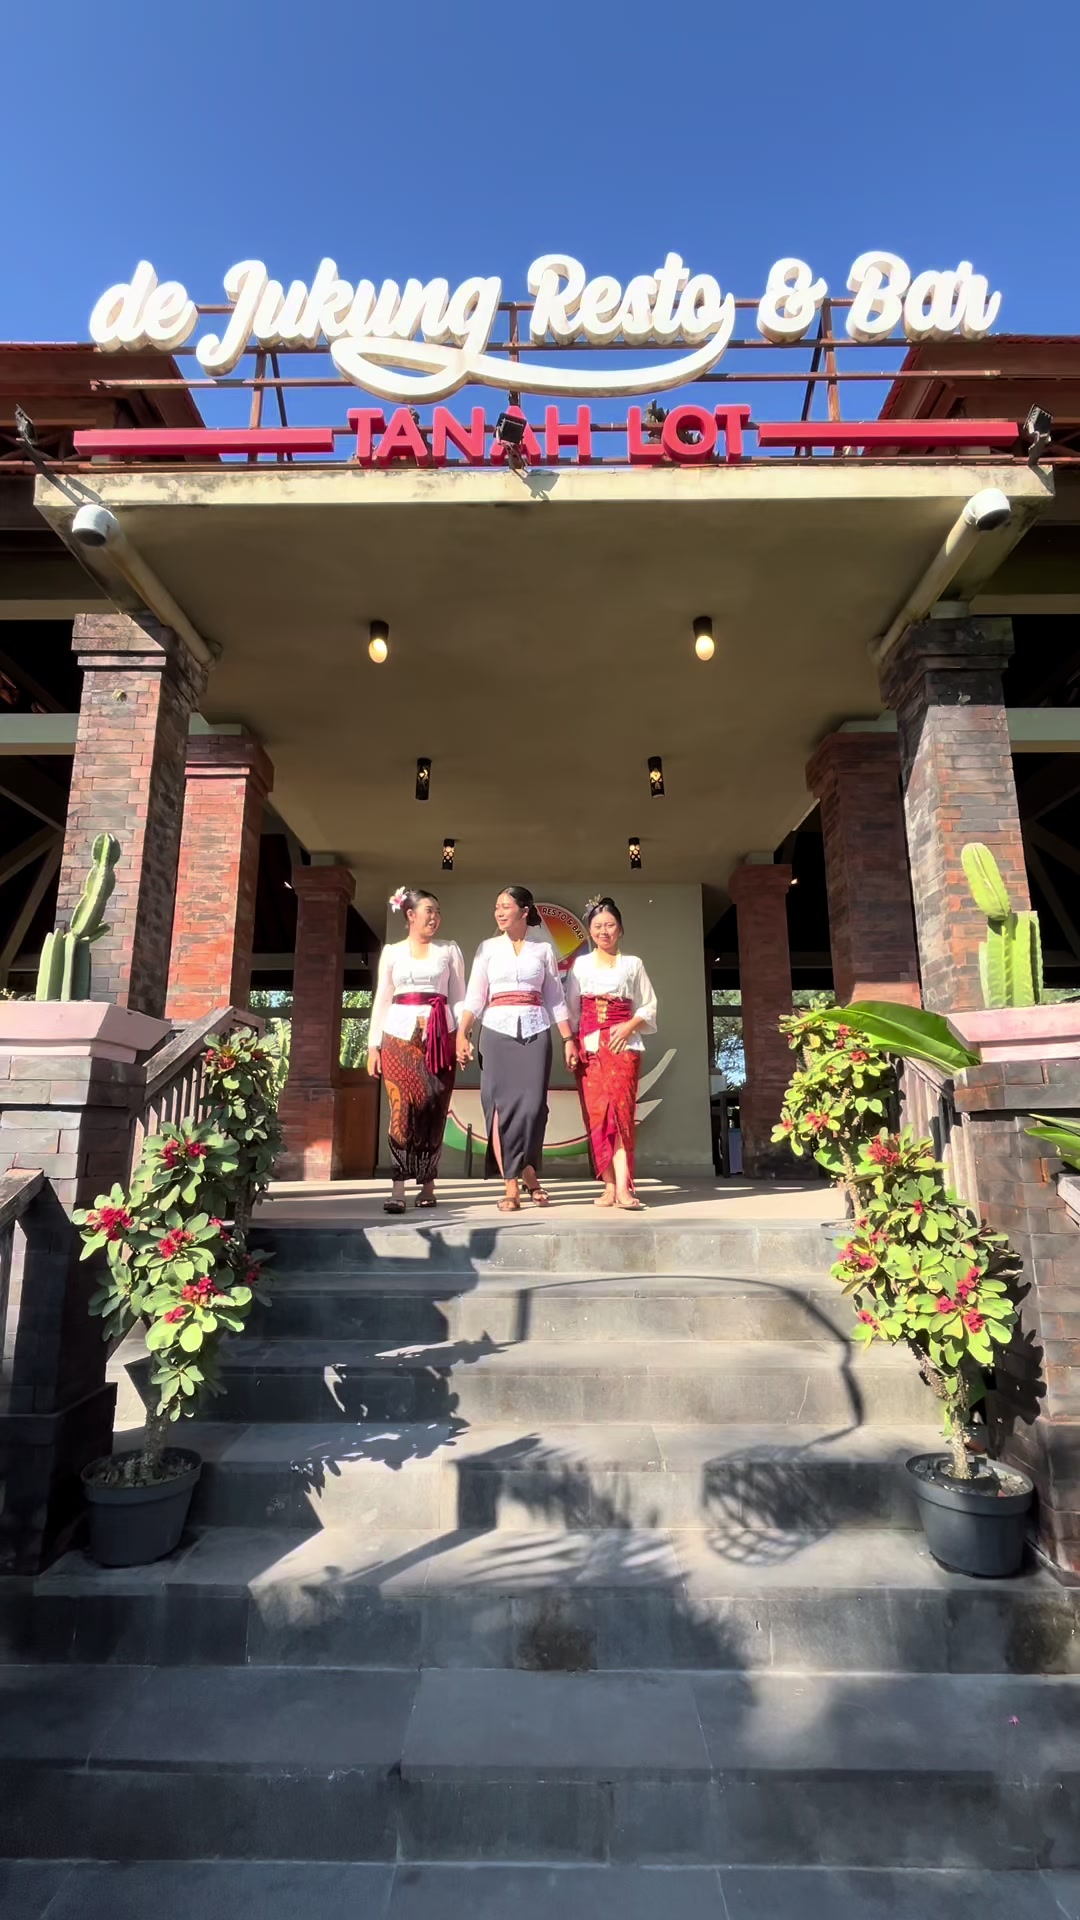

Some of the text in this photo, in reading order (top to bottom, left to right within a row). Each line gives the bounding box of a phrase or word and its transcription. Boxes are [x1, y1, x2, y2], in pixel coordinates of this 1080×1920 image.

[89, 251, 1003, 405] de Jukung Resto & Bar
[347, 404, 752, 467] TANAH LOT
[542, 907, 584, 940] RESTO & BAR
